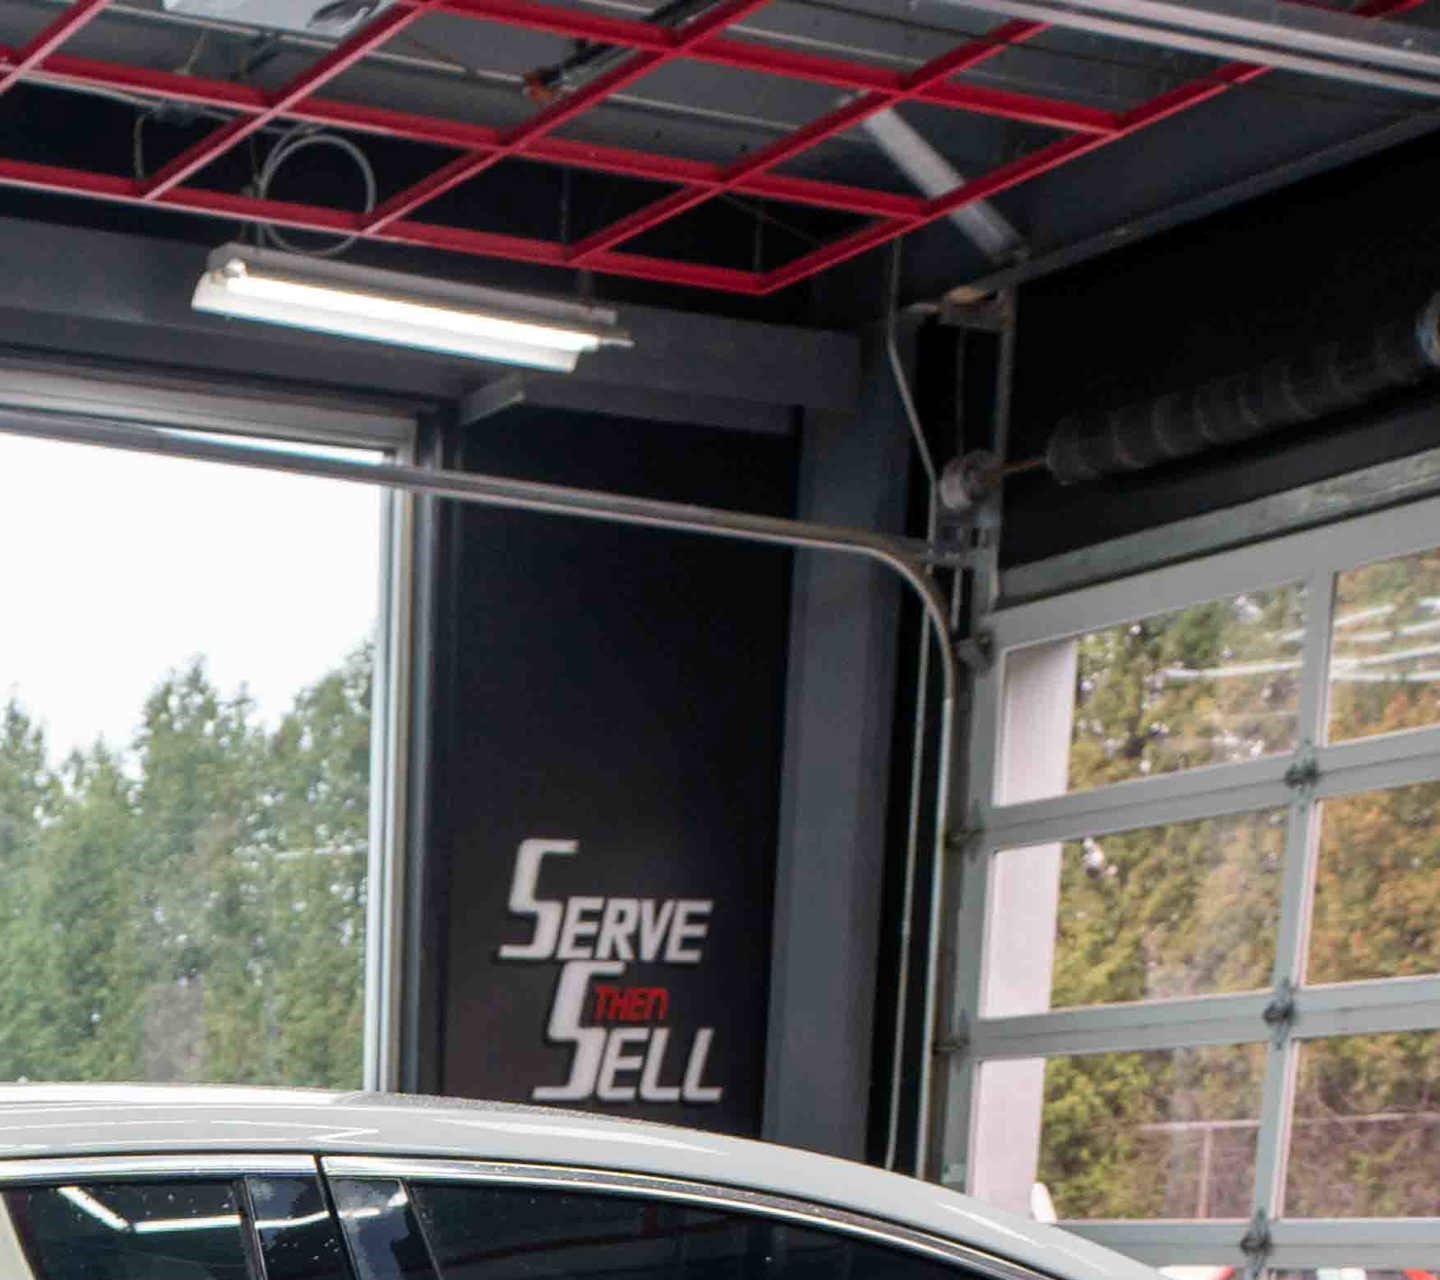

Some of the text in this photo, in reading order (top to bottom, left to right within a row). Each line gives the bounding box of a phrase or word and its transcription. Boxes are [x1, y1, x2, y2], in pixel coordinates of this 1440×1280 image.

[497, 838, 713, 962] SERVE
[532, 960, 723, 1101] SELL
[593, 985, 669, 1022] THEN
